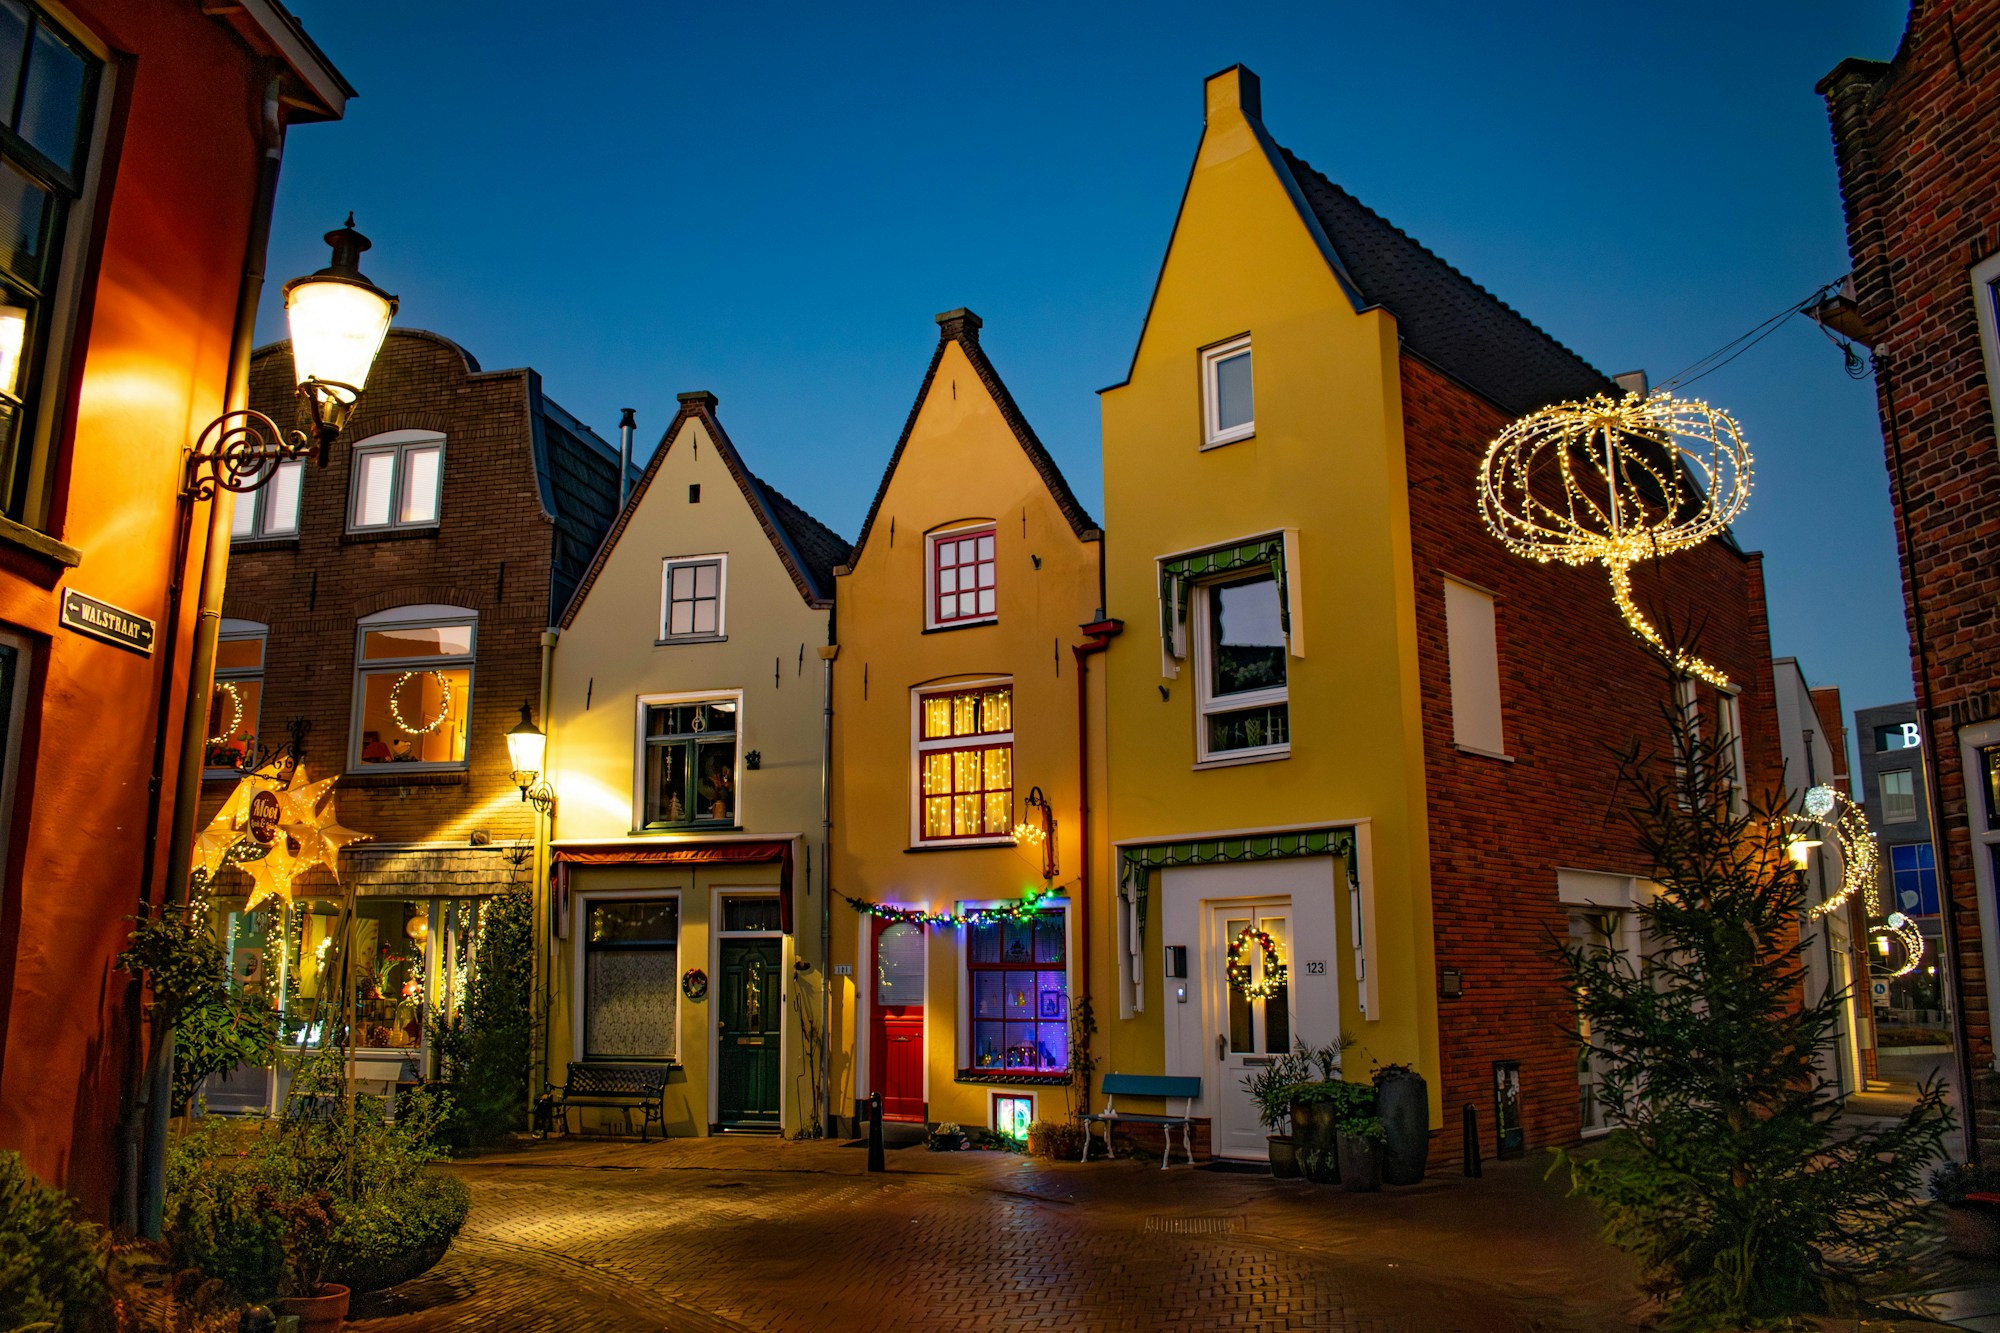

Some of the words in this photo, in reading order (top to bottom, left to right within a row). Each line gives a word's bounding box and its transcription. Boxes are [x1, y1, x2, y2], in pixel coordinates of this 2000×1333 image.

[81, 602, 141, 639] WALSTRAAT
[1900, 722, 1921, 749] B
[253, 798, 279, 820] Mooi
[1306, 962, 1324, 974] 123
